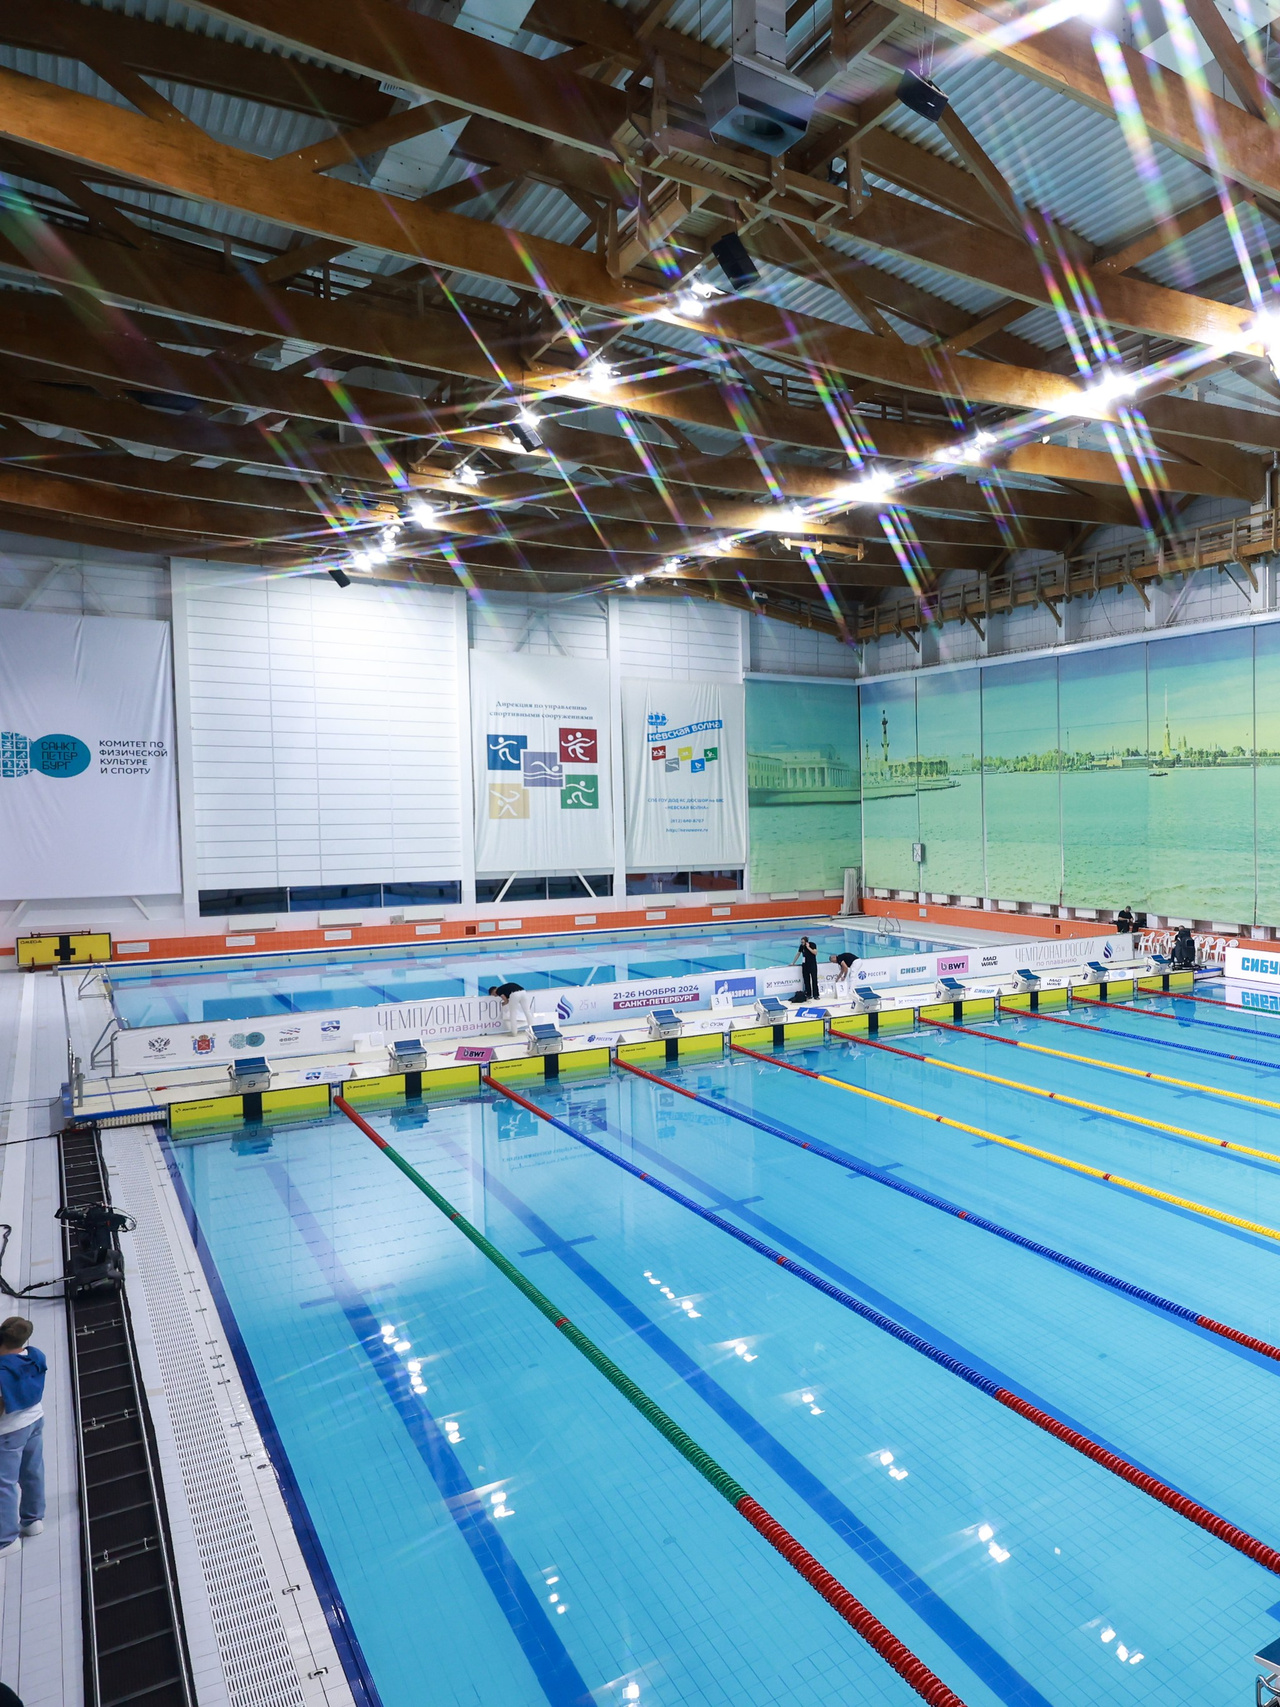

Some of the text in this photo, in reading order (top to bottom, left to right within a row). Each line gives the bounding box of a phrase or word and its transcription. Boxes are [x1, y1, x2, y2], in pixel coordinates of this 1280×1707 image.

[496, 701, 532, 709] Дирекция
[489, 711, 540, 719] спортивными
[42, 742, 77, 750] САНКТ
[99, 740, 146, 748] КОМИТЕТ
[42, 752, 78, 760] ПЕТЕР
[99, 748, 168, 757] ФИЗИЧЕСКОЙ
[42, 760, 72, 770] БУРГ
[100, 758, 148, 766] КУЛЬТУРЕ
[110, 767, 151, 775] СПОРТУ
[1015, 941, 1094, 962] ЧЕМПИОНАТ РОССИИ
[900, 966, 927, 974] СИБУР
[948, 962, 965, 970] BWT
[613, 984, 699, 999] 21-26 НОЯБРЯ 2024
[579, 1000, 589, 1010] 25
[619, 994, 694, 1008] САНКТ-ПЕТЕРБУРГ
[377, 1002, 475, 1031] ЧЕМПИОНАТ
[420, 1020, 502, 1036] по плаванию
